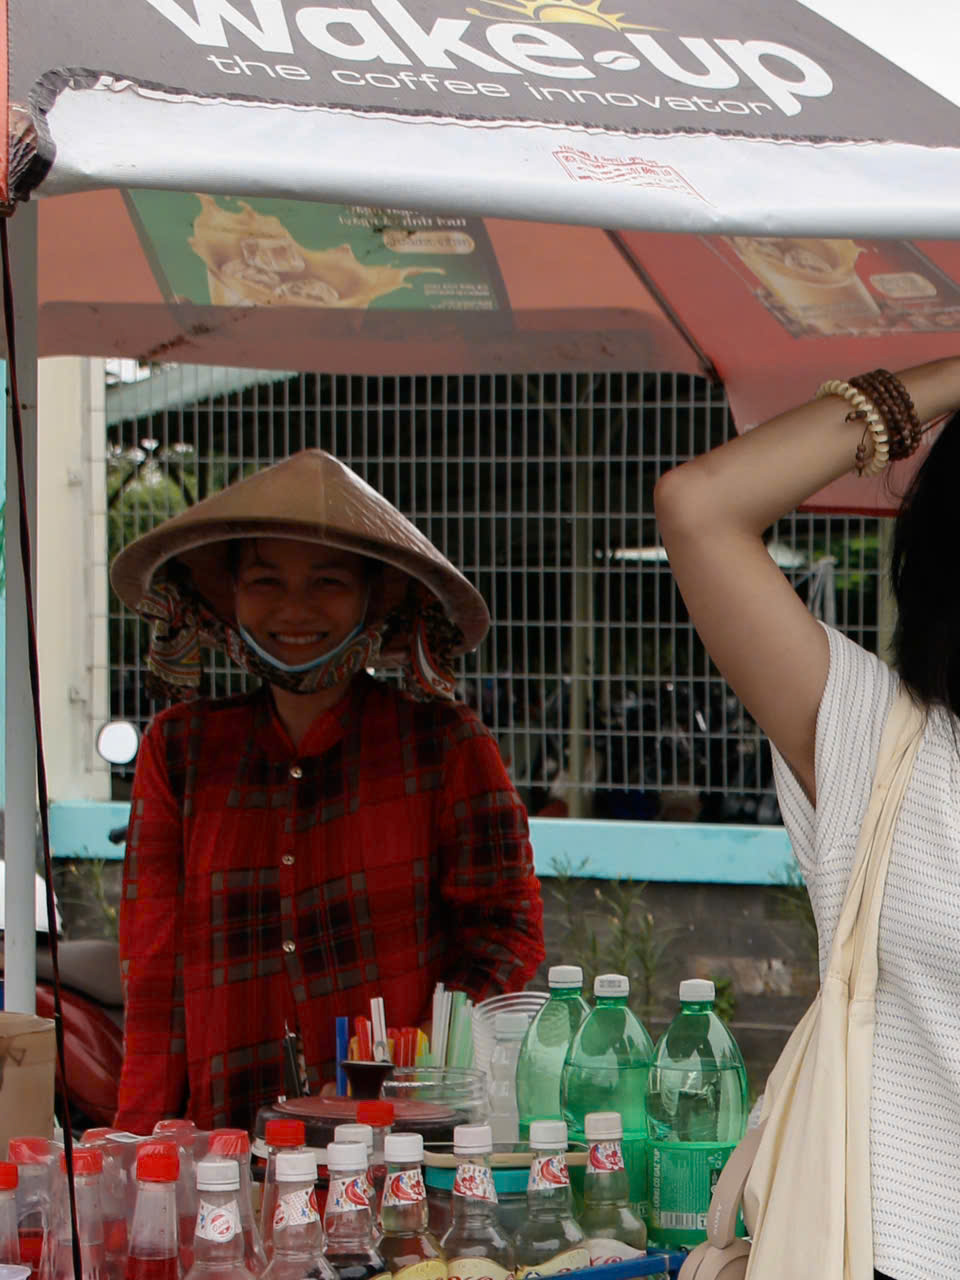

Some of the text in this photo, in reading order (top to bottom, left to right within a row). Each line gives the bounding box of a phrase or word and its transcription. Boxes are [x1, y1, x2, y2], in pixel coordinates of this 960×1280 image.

[207, 55, 773, 116] the coffee innovator
